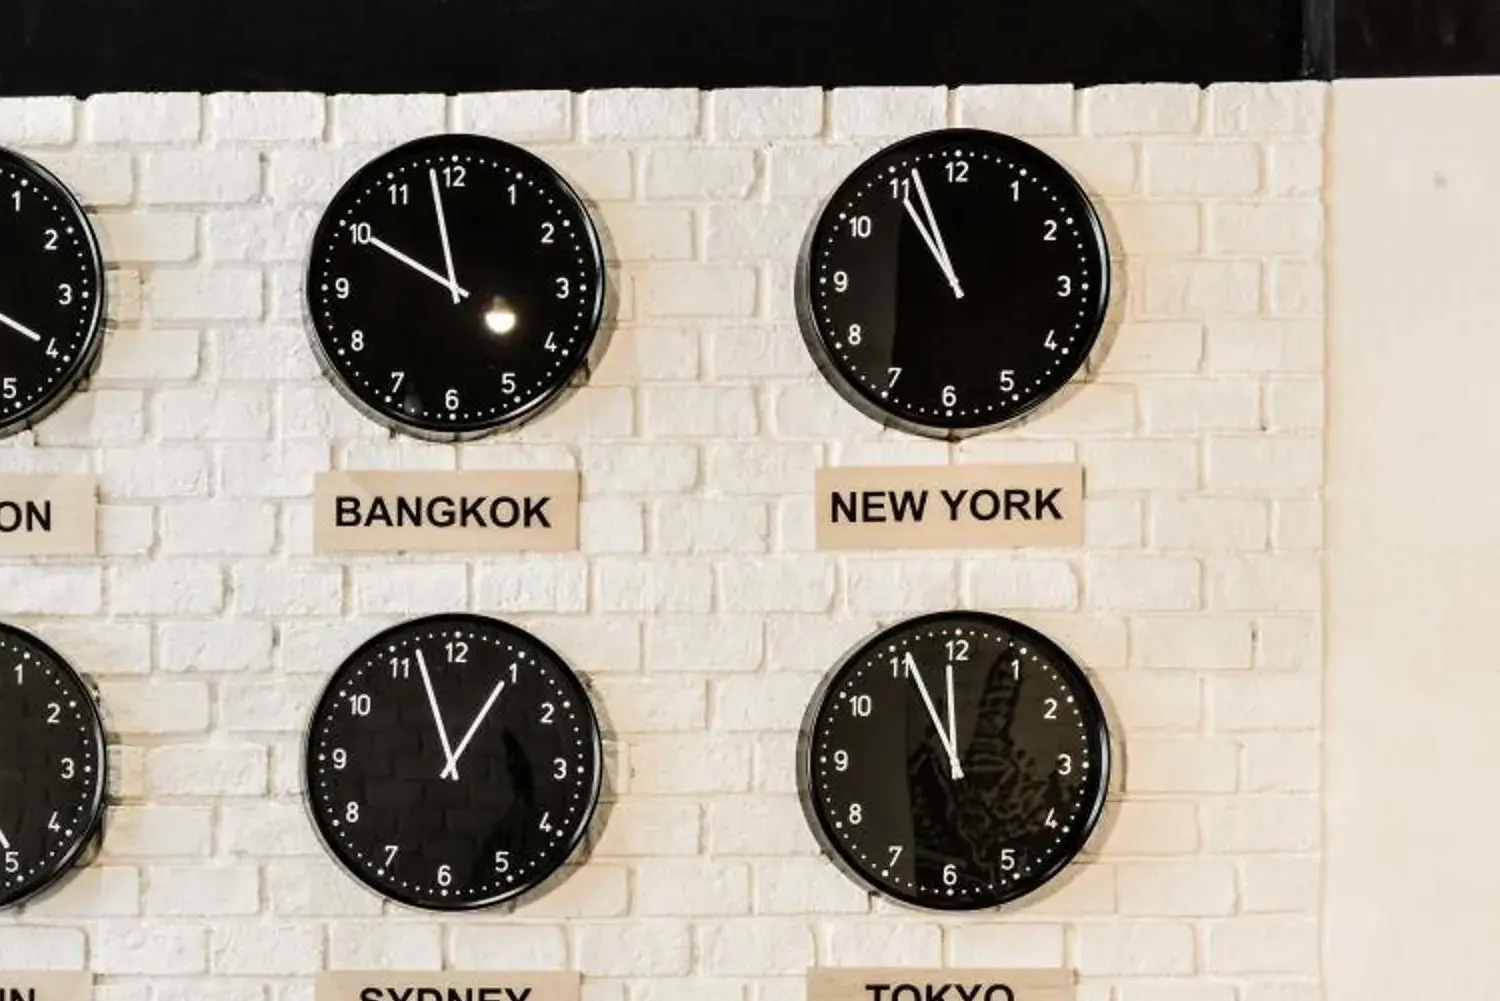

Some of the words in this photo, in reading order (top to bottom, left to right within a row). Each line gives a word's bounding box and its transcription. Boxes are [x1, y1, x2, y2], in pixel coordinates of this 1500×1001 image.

[442, 165, 466, 188] 12
[945, 160, 969, 183] 12
[388, 183, 408, 205] 11
[507, 183, 516, 205] 1
[889, 177, 910, 200] 11
[1010, 180, 1019, 202] 1
[11, 190, 21, 212] 1
[349, 222, 372, 243] 10
[541, 222, 555, 244] 2
[849, 215, 872, 238] 10
[1043, 219, 1057, 241] 2
[44, 228, 59, 251] 2
[335, 277, 350, 299] 9
[555, 277, 570, 299] 3
[833, 270, 848, 293] 9
[1057, 275, 1071, 297] 3
[58, 283, 73, 305] 3
[350, 329, 364, 352] 8
[543, 331, 557, 353] 4
[847, 323, 862, 346] 8
[1043, 329, 1058, 351] 4
[45, 337, 59, 359] 4
[3, 377, 17, 399] 5
[391, 371, 405, 393] 7
[501, 372, 516, 394] 5
[887, 367, 902, 389] 7
[1000, 369, 1015, 392] 5
[445, 388, 459, 411] 6
[942, 385, 957, 407] 6
[335, 495, 551, 529] BANGKOK
[831, 490, 929, 523] NEW
[940, 487, 1063, 521] YORK
[445, 641, 469, 663] 12
[945, 639, 969, 661] 12
[14, 663, 23, 685] 1
[389, 657, 410, 678] 11
[509, 662, 517, 684] 1
[1011, 659, 1019, 680] 1
[47, 702, 61, 724] 2
[349, 693, 371, 716] 10
[540, 701, 555, 724] 2
[849, 694, 872, 717] 10
[1043, 697, 1058, 720] 2
[61, 757, 75, 779] 3
[332, 748, 347, 770] 9
[553, 757, 567, 780] 3
[833, 749, 849, 772] 9
[1058, 753, 1072, 776] 3
[47, 811, 61, 832] 4
[345, 801, 359, 823] 8
[539, 811, 553, 833] 4
[848, 803, 862, 825] 8
[1044, 807, 1058, 829] 4
[5, 851, 19, 873] 5
[384, 845, 399, 867] 7
[495, 850, 509, 873] 5
[888, 845, 903, 867] 7
[1000, 848, 1015, 871] 5
[437, 864, 452, 887] 6
[943, 863, 957, 886] 6
